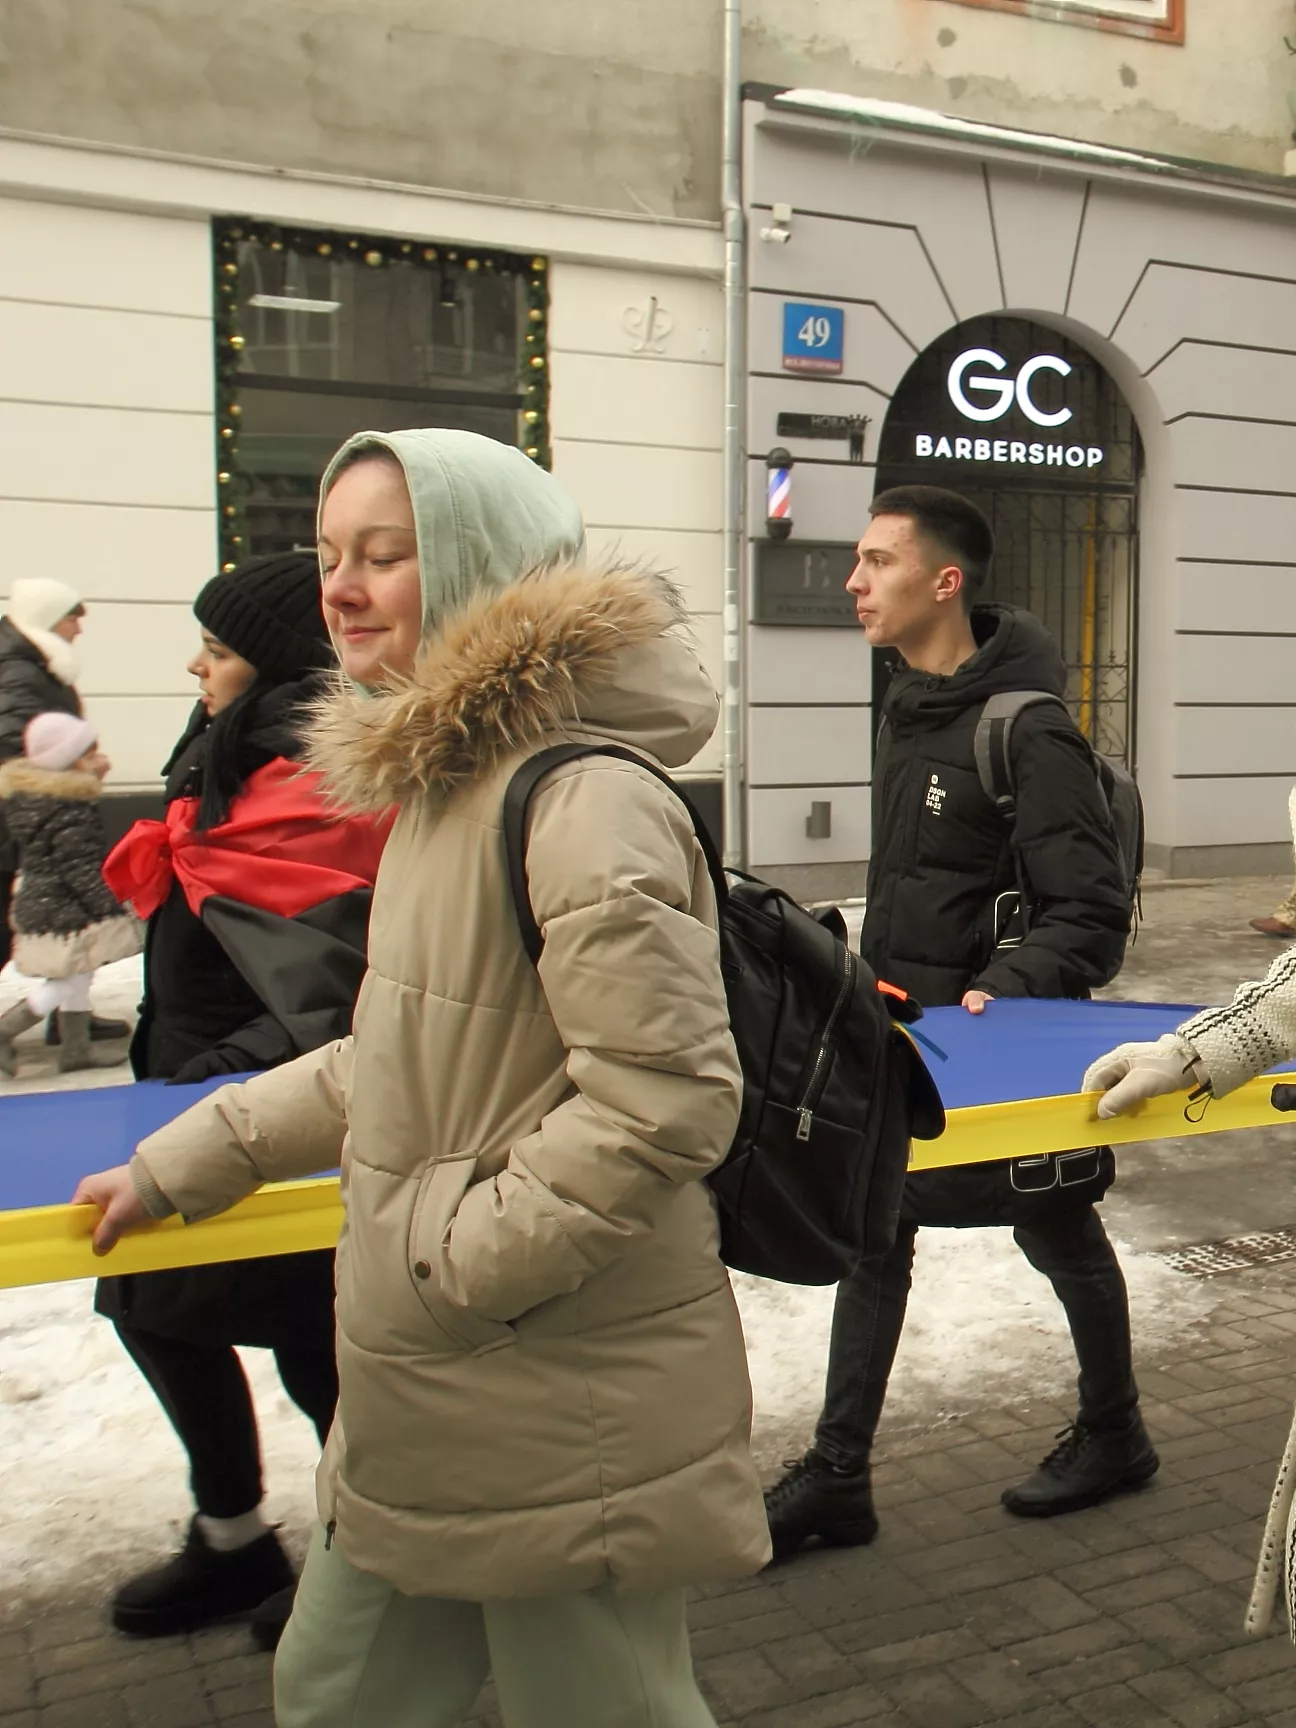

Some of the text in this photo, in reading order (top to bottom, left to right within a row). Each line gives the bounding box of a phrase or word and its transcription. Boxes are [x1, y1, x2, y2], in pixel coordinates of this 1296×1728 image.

[798, 316, 831, 348] 49
[947, 348, 1073, 427] GC
[915, 434, 1104, 468] BARBERSHOP
